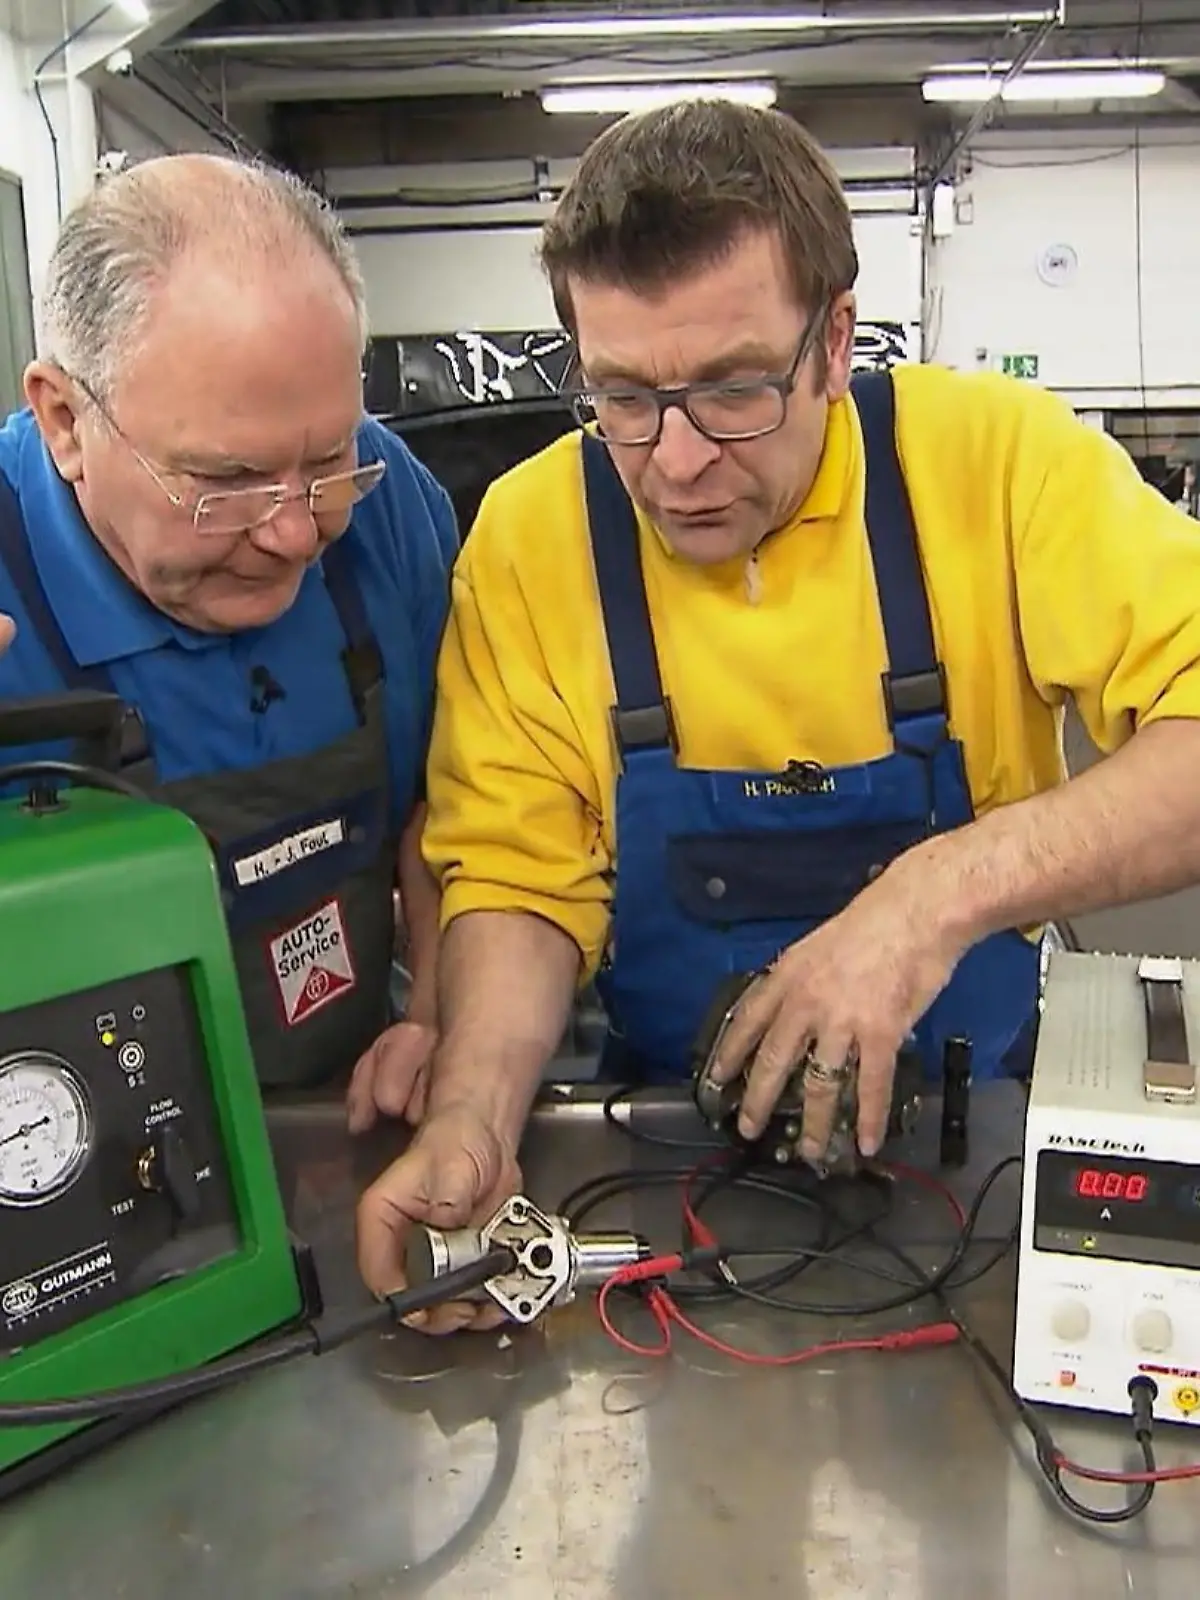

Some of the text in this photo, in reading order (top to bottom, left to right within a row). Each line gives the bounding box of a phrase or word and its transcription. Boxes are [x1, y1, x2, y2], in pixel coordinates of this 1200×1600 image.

[281, 915, 331, 956] AUTO-
[278, 931, 340, 979] Service
[144, 1106, 183, 1126] CONTROL
[111, 1198, 135, 1216] TEST
[1100, 1207, 1112, 1221] A
[41, 1252, 112, 1293] GUTMANN
